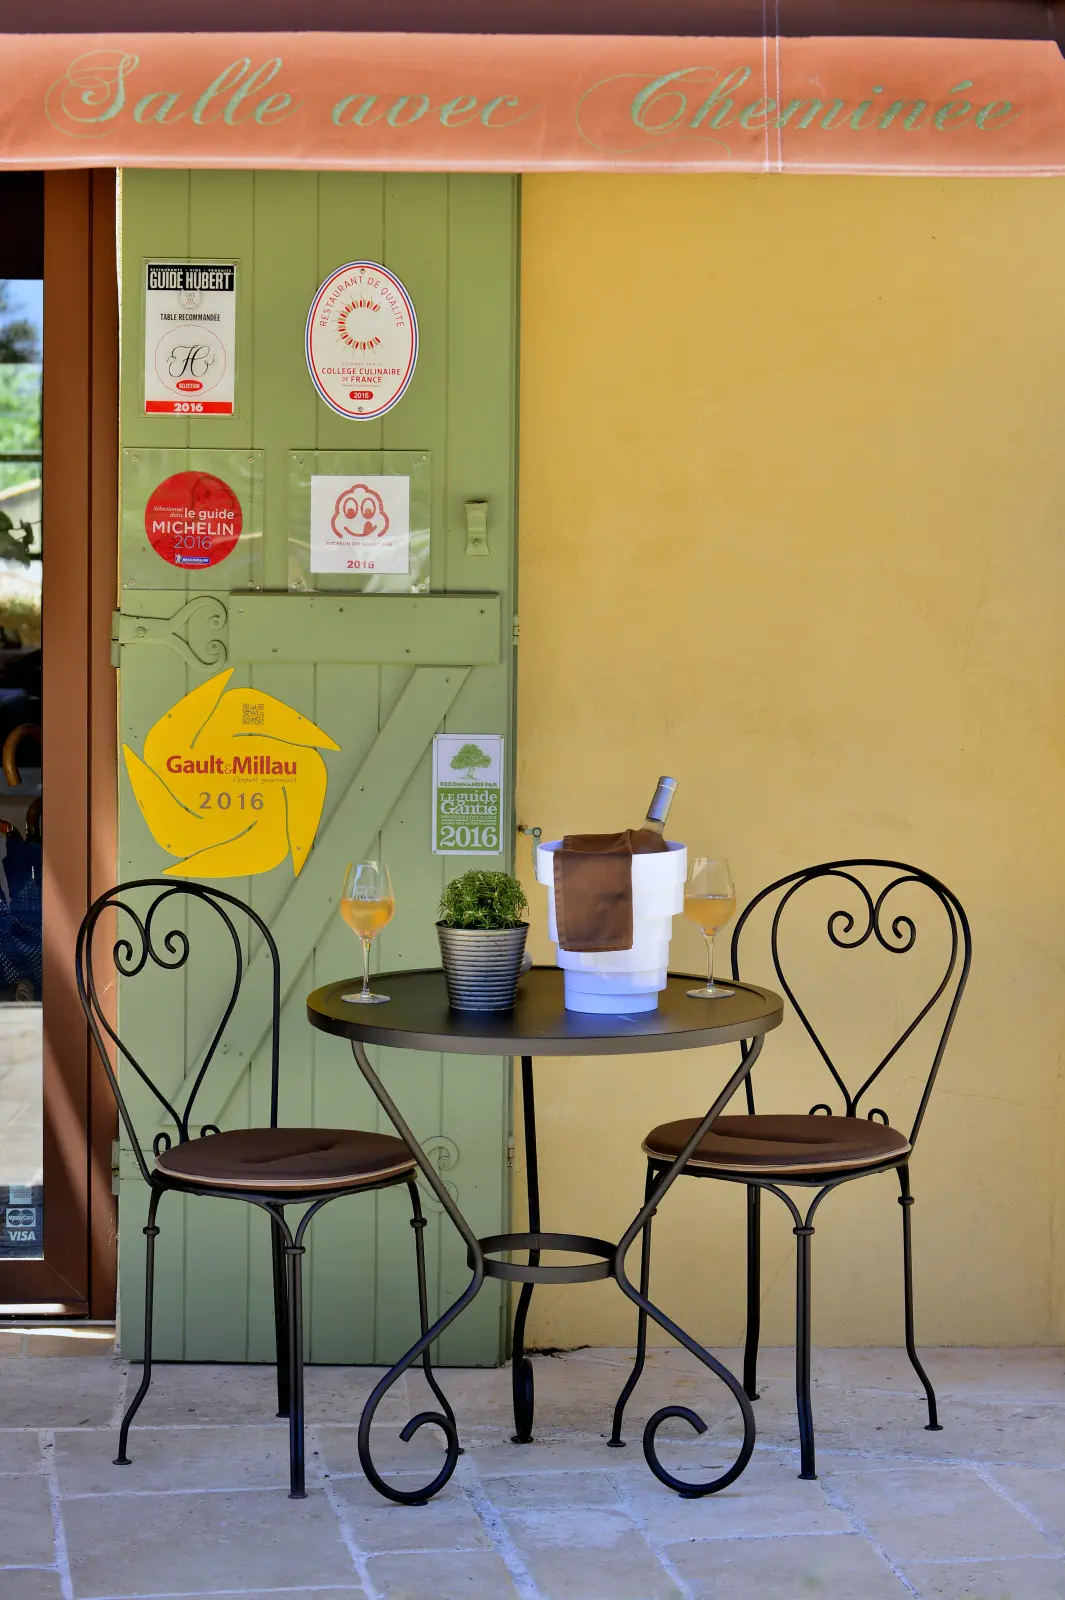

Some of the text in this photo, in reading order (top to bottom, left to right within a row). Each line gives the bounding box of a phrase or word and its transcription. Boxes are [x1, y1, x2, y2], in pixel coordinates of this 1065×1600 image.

[45, 50, 1022, 157] Salle avec Cheminée
[149, 271, 231, 290] GUIDE HUBERT
[319, 275, 364, 327] RESTAURANT
[367, 276, 381, 289] DE
[160, 312, 221, 322] TABLE RECOMMANDÉE
[359, 367, 401, 376] CULINAIRE
[350, 376, 382, 384] FRANCE
[353, 391, 370, 399] 2016
[173, 402, 204, 413] 2016
[184, 507, 235, 521] le guide
[151, 520, 234, 536] MICHELIN
[173, 535, 213, 550] 2016
[346, 560, 375, 570] 2016
[166, 754, 297, 775] Gault&Millau
[199, 791, 264, 811] 2016
[439, 790, 498, 806] LE guide
[440, 800, 498, 816] Gantié
[439, 825, 498, 848] 2016
[8, 1230, 36, 1242] VISA
